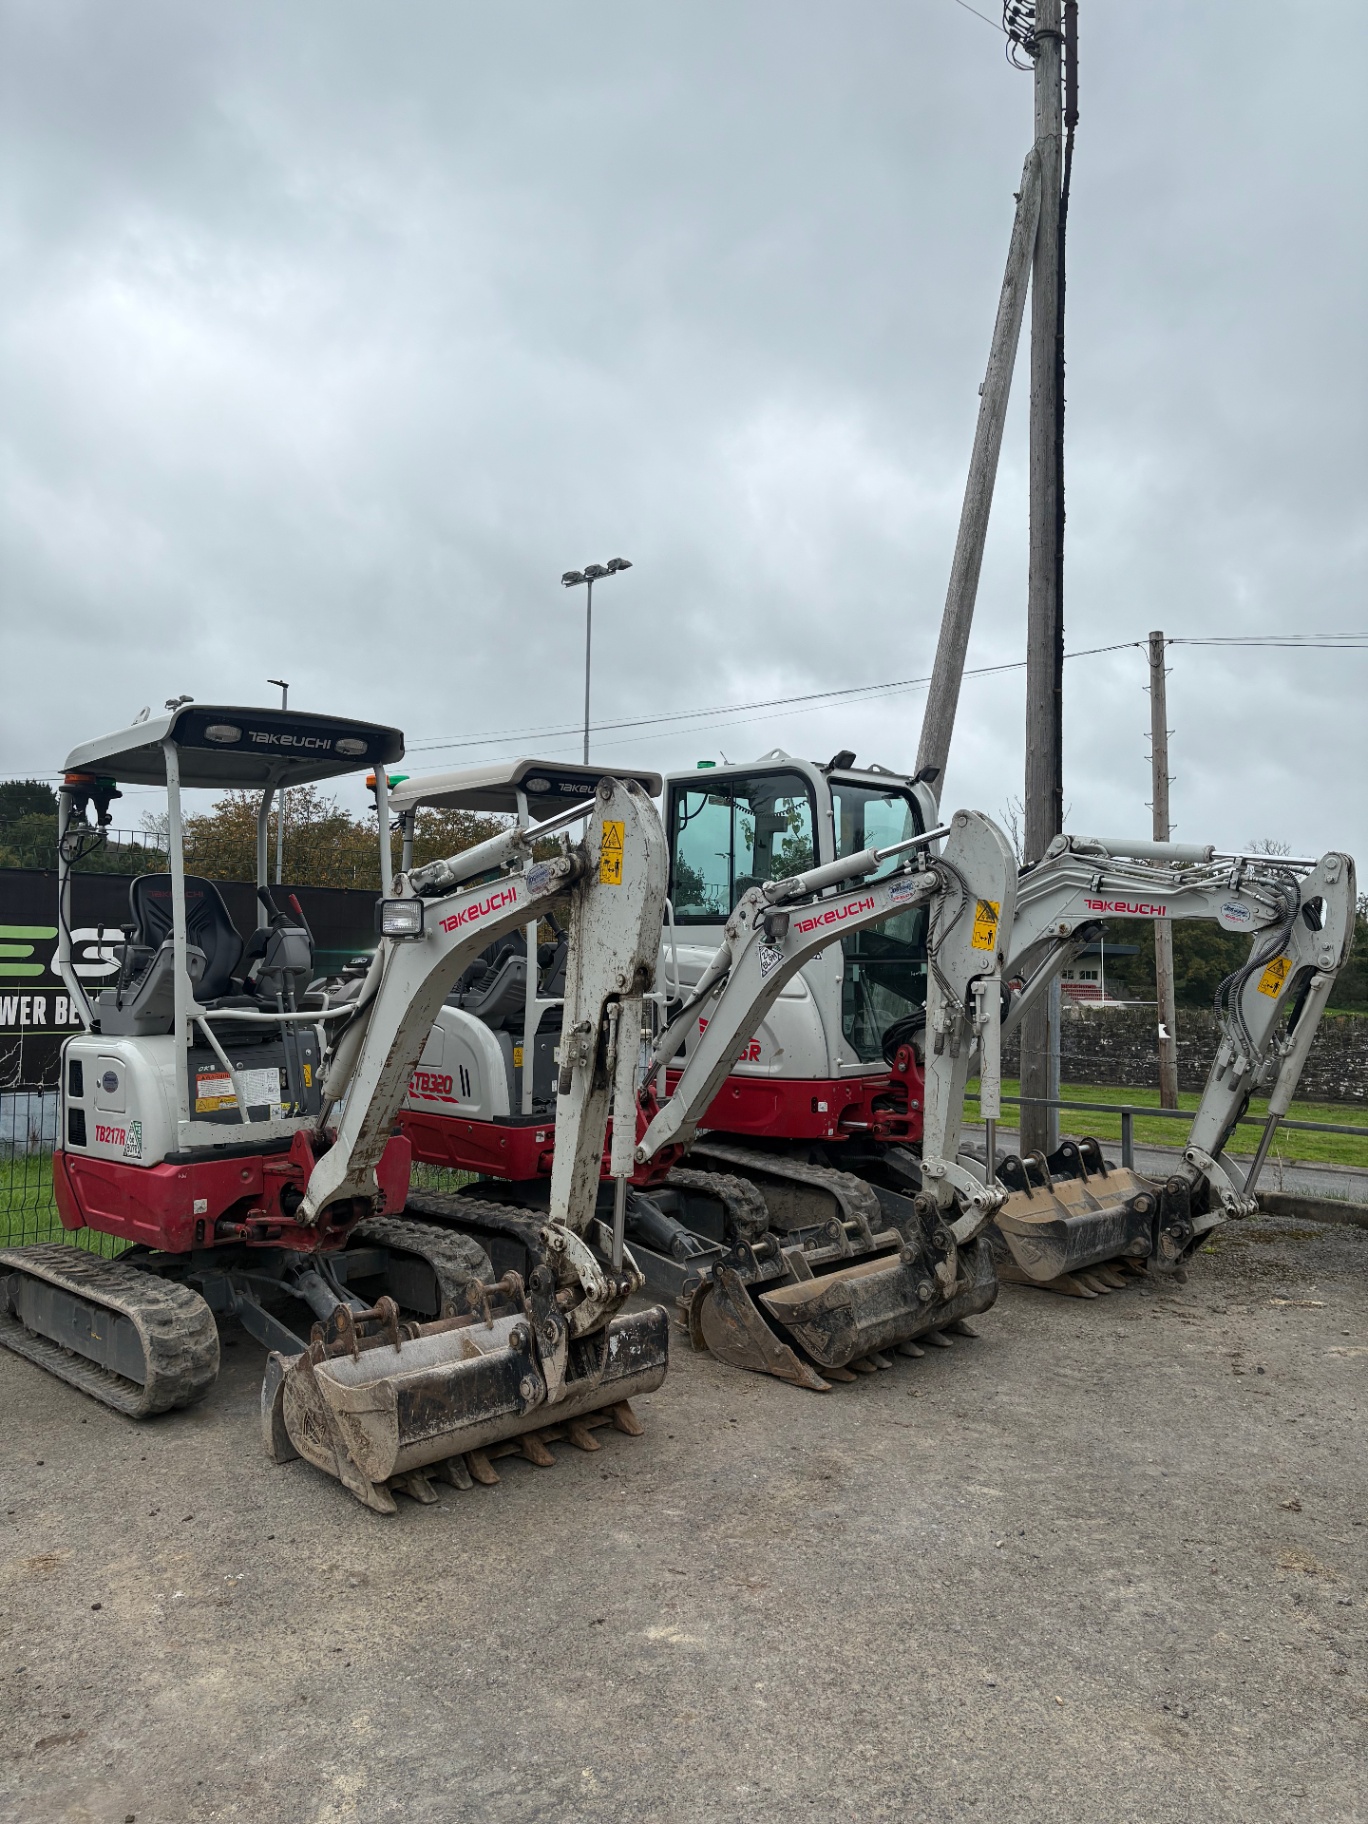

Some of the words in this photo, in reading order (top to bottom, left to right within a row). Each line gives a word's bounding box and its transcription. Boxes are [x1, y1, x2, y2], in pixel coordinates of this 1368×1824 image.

[248, 731, 332, 750] TAKEUCHI
[438, 886, 518, 934] TAKEUCHI
[793, 896, 875, 934] TAKEUCHI
[1084, 899, 1166, 916] TAKEUCHI
[413, 1071, 454, 1095] TB320
[95, 1125, 126, 1146] TB217R
